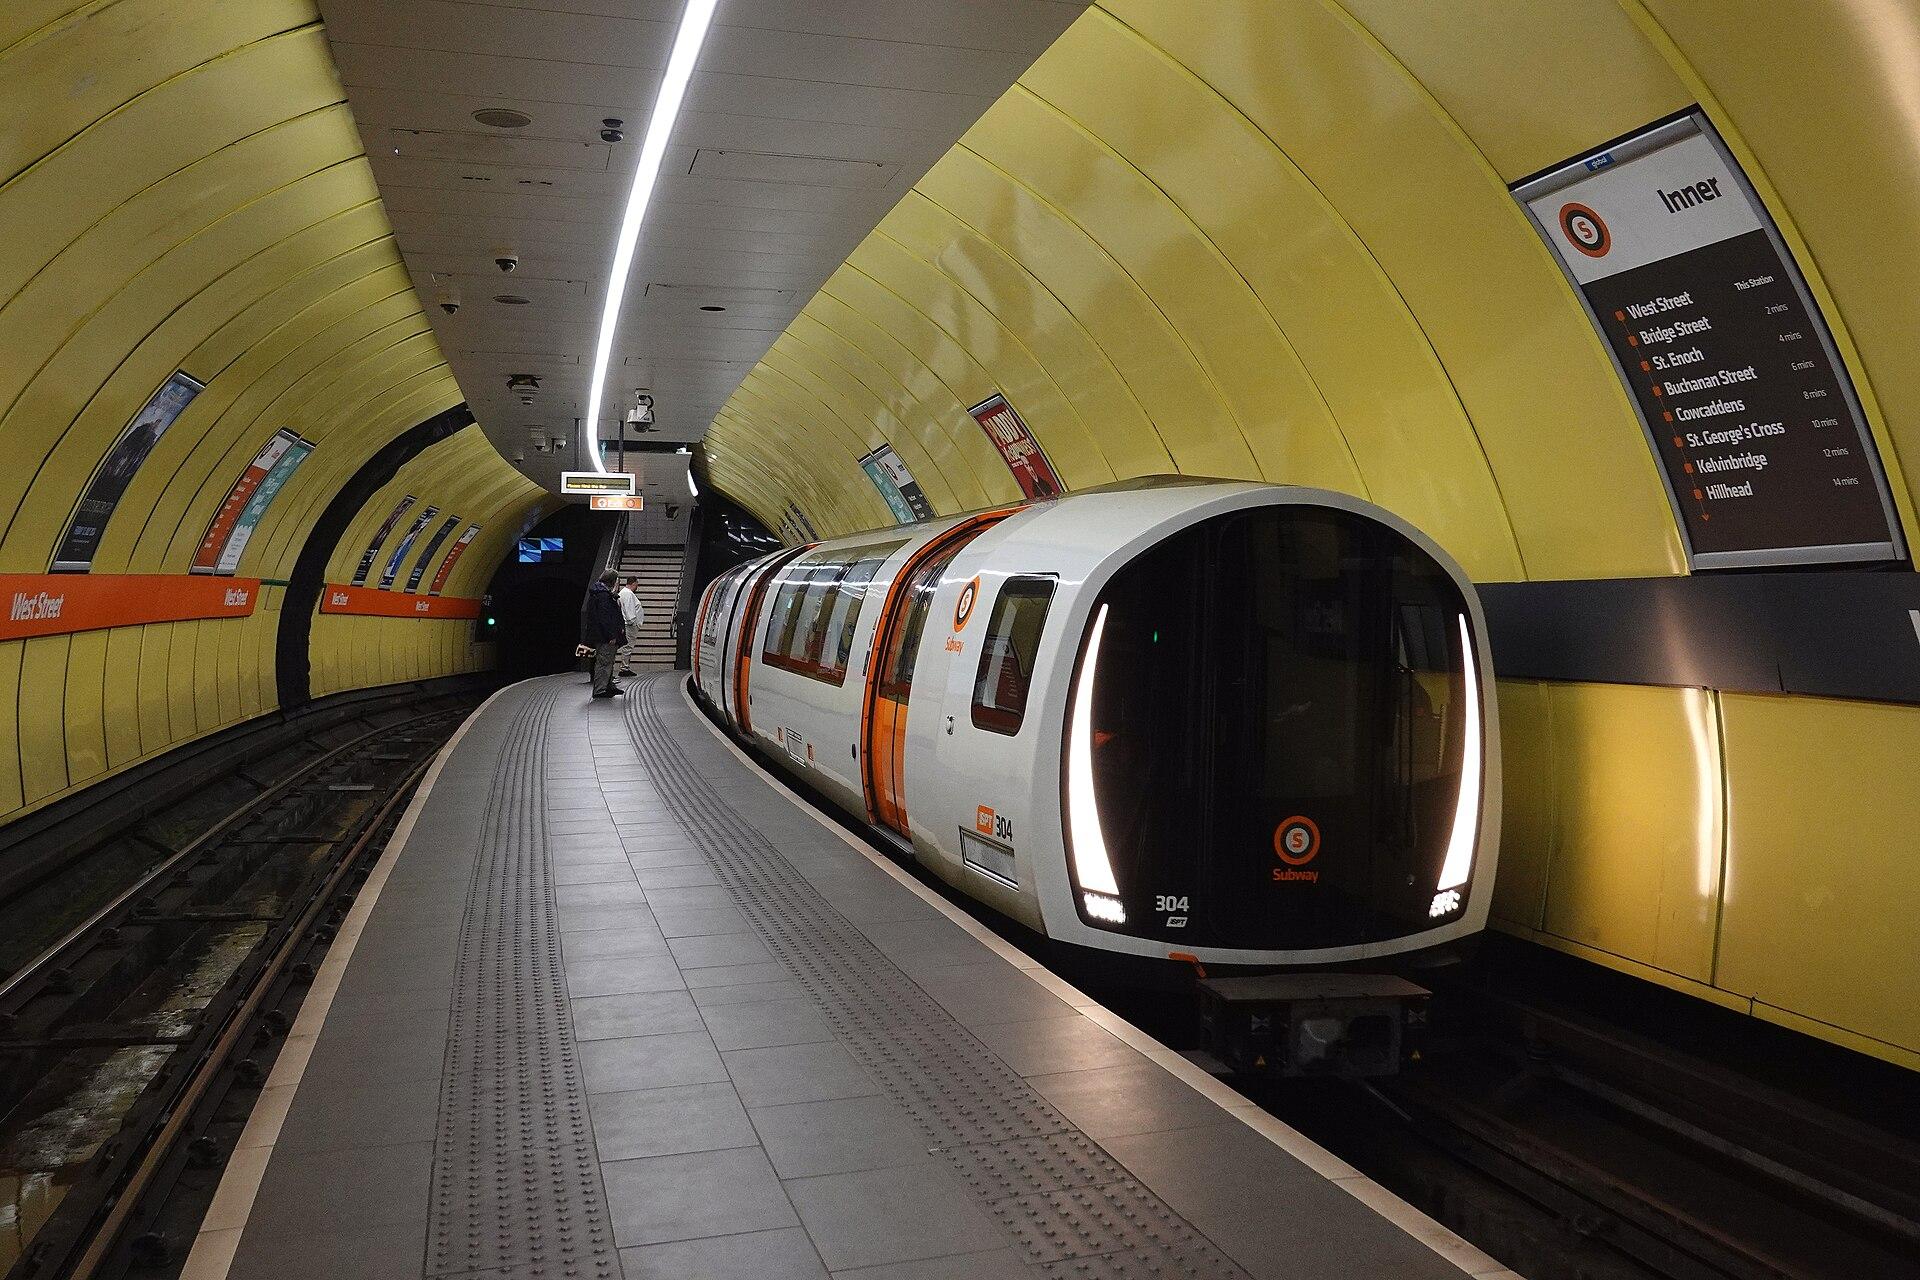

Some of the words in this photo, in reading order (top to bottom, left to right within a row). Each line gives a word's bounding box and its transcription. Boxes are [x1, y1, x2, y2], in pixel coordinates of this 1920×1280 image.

[1656, 177, 1722, 214] Inner
[1734, 282, 1749, 292] This
[1748, 275, 1775, 289] Station
[1626, 300, 1659, 320] West
[1656, 291, 1694, 313] Street
[1771, 303, 1789, 314] mins
[1639, 325, 1676, 345] Bridge
[1674, 316, 1712, 337] Street
[1784, 331, 1802, 342] mins
[1652, 353, 1670, 371] St.
[1668, 346, 1705, 367] Enoch
[1797, 359, 1815, 370] mins
[1663, 374, 1722, 396] Buchanan
[1719, 365, 1758, 386] Street
[1809, 388, 1827, 398] mins
[1675, 399, 1746, 422] Cowcaddens
[1811, 419, 1821, 428] 10
[1820, 416, 1838, 427] mins
[1686, 433, 1704, 448] St.
[1702, 424, 1751, 445] George's
[1750, 421, 1786, 439] Cross
[1822, 448, 1832, 458] 12
[1831, 446, 1849, 457] mins
[1696, 452, 1768, 474] Kelvinbridge
[1706, 481, 1753, 500] Hillhead
[1832, 477, 1842, 487] 14
[1841, 476, 1859, 485] mins
[10, 592, 38, 621] West
[35, 592, 65, 620] Street
[945, 636, 965, 656] Subway
[996, 814, 1013, 841] 304
[1272, 868, 1319, 883] Subway
[1155, 895, 1190, 912] 304
